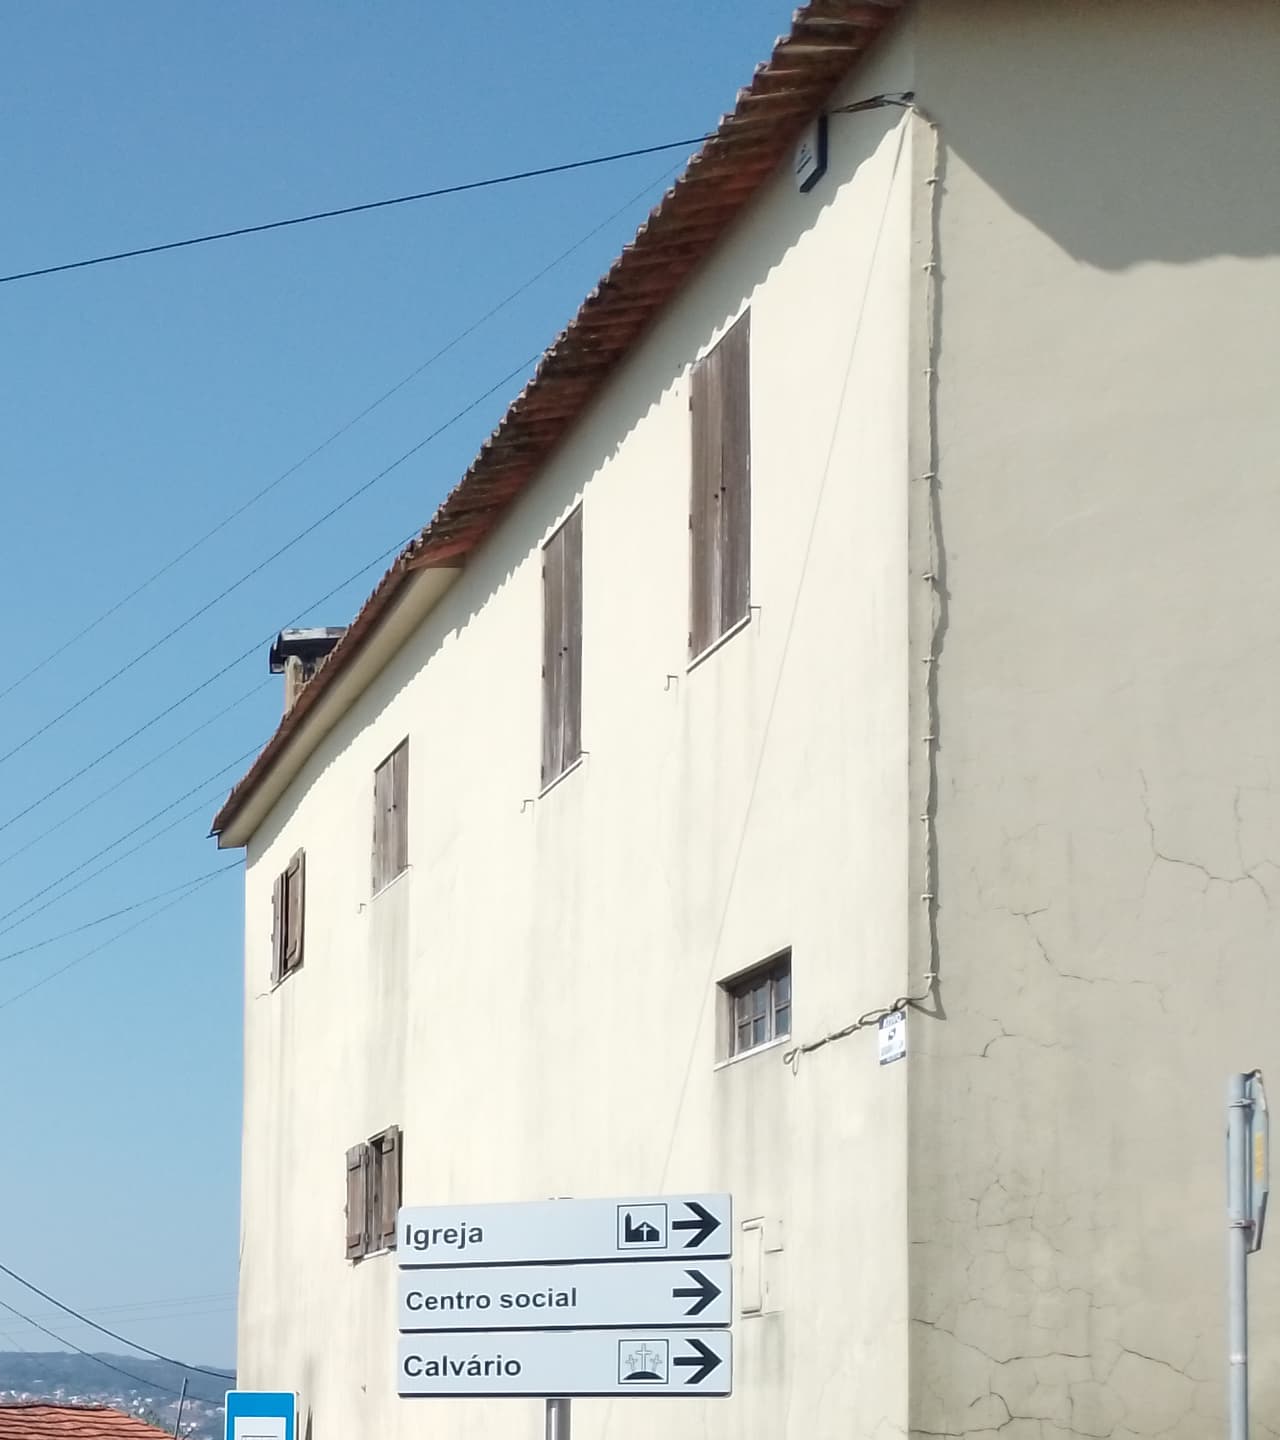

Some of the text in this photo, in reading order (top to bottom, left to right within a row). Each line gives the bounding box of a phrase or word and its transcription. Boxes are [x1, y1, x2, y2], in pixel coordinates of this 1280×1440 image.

[405, 1222, 484, 1251] Igreja
[405, 1287, 577, 1311] Centro social
[403, 1354, 522, 1377] Calvário
